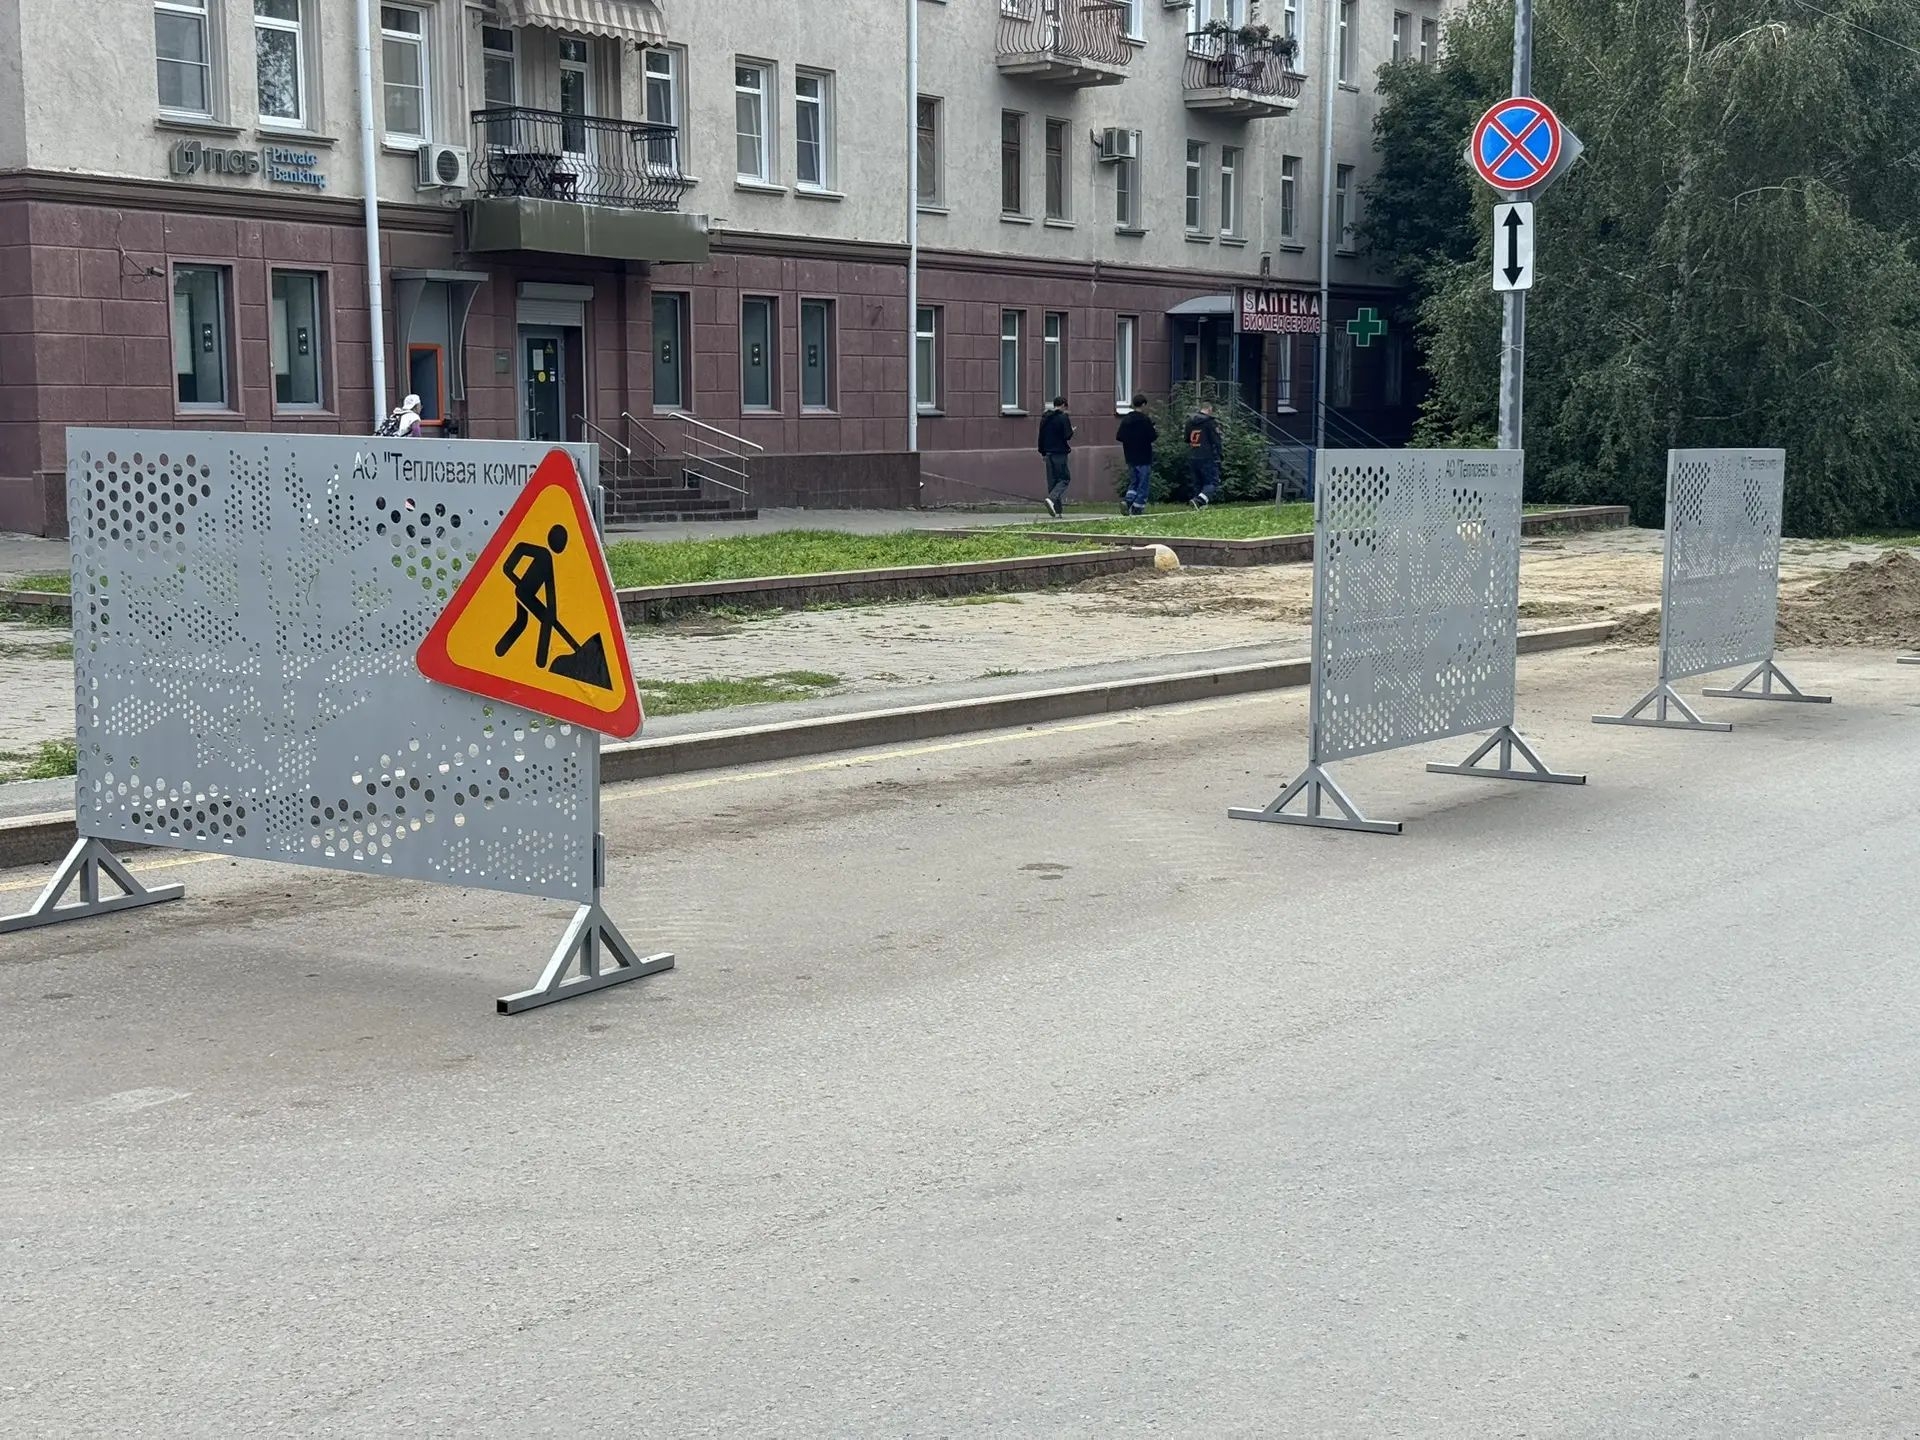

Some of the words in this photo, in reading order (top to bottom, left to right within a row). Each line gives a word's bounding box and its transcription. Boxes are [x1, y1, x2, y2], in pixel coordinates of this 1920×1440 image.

[203, 147, 260, 174] ПСБ
[272, 146, 318, 166] Private
[273, 165, 328, 190] Banking
[1257, 291, 1320, 315] АПТЕКА
[1243, 313, 1321, 334] БИОМЕДСЕРВИС
[352, 451, 378, 480] АО
[384, 451, 477, 485] "Тепловая
